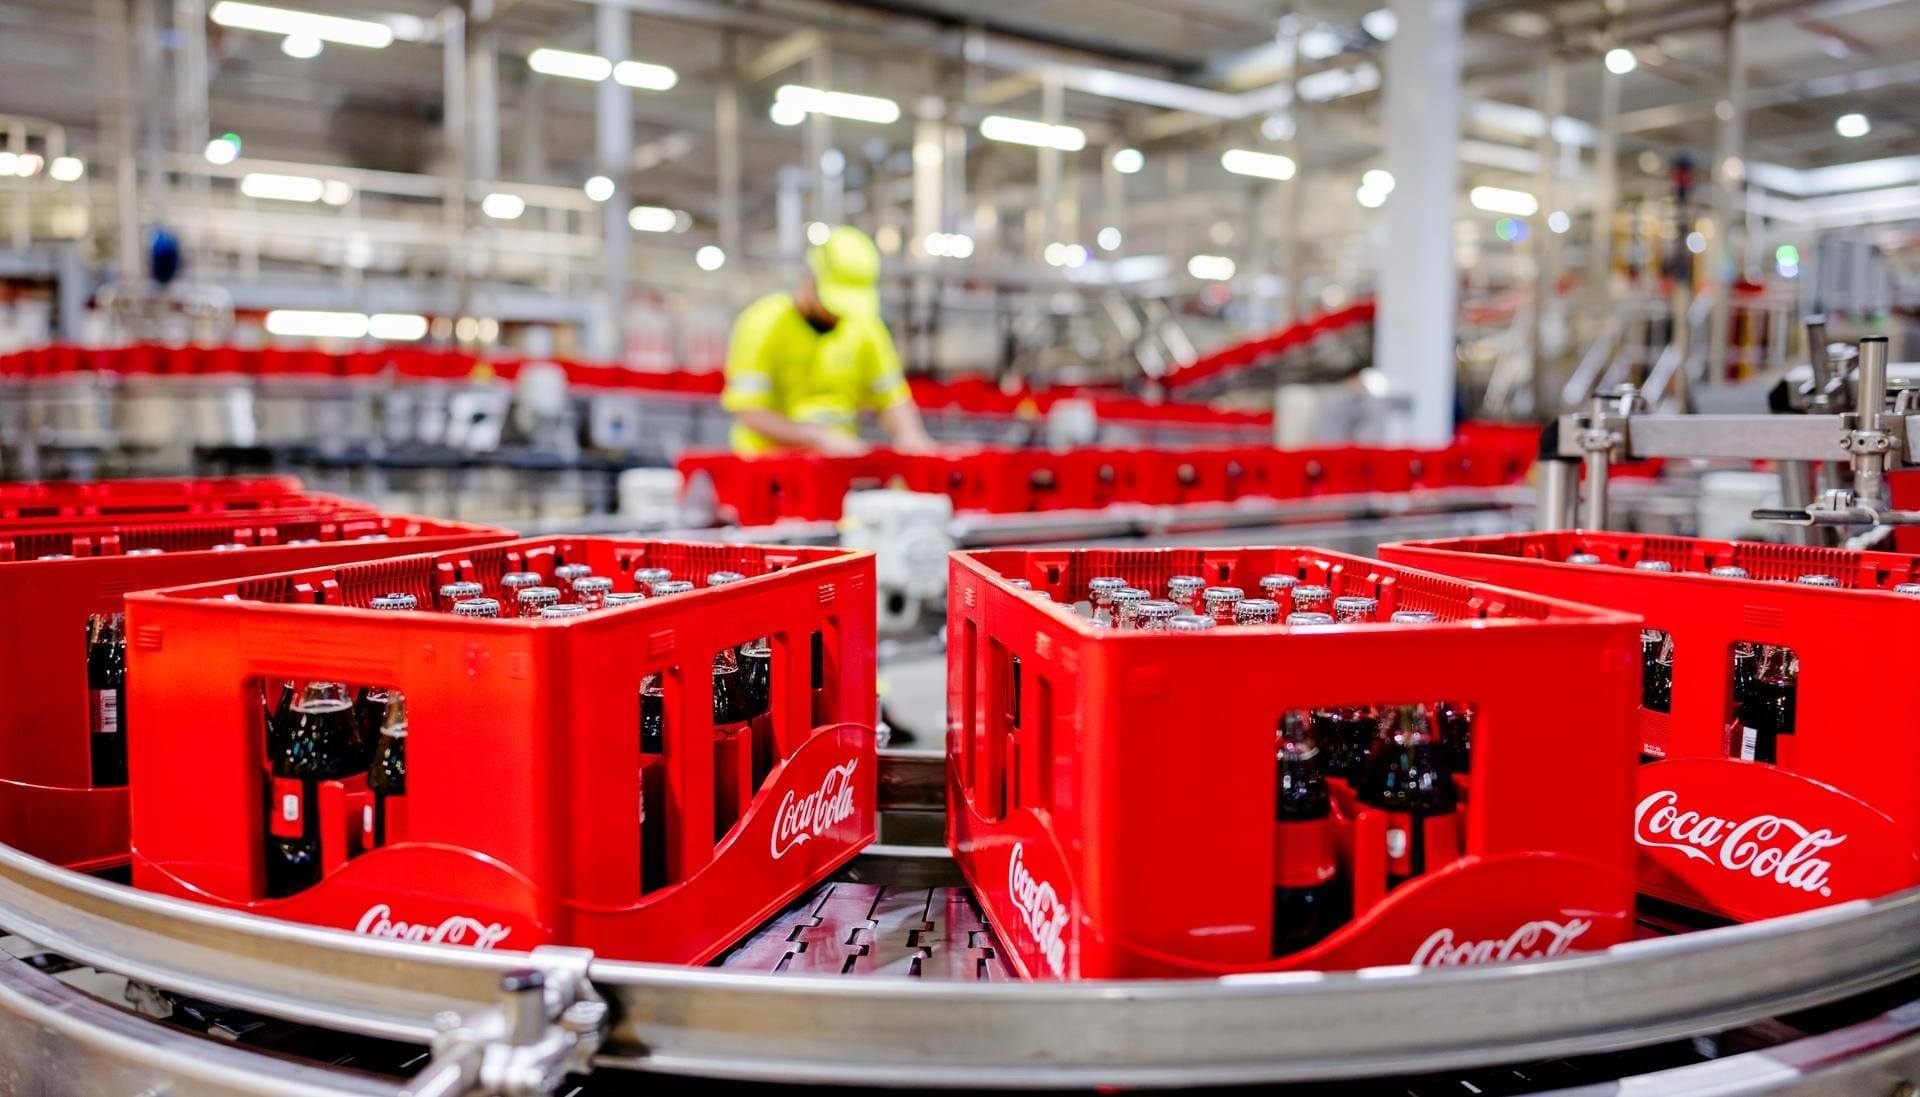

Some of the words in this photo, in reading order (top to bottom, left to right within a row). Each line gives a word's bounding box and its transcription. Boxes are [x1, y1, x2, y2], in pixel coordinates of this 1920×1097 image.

[771, 757, 858, 859] Coca-Cola
[1634, 790, 1848, 897] Coca-Cola
[355, 904, 512, 950] Coca-Cl
[1008, 841, 1070, 977] Coca-Cola
